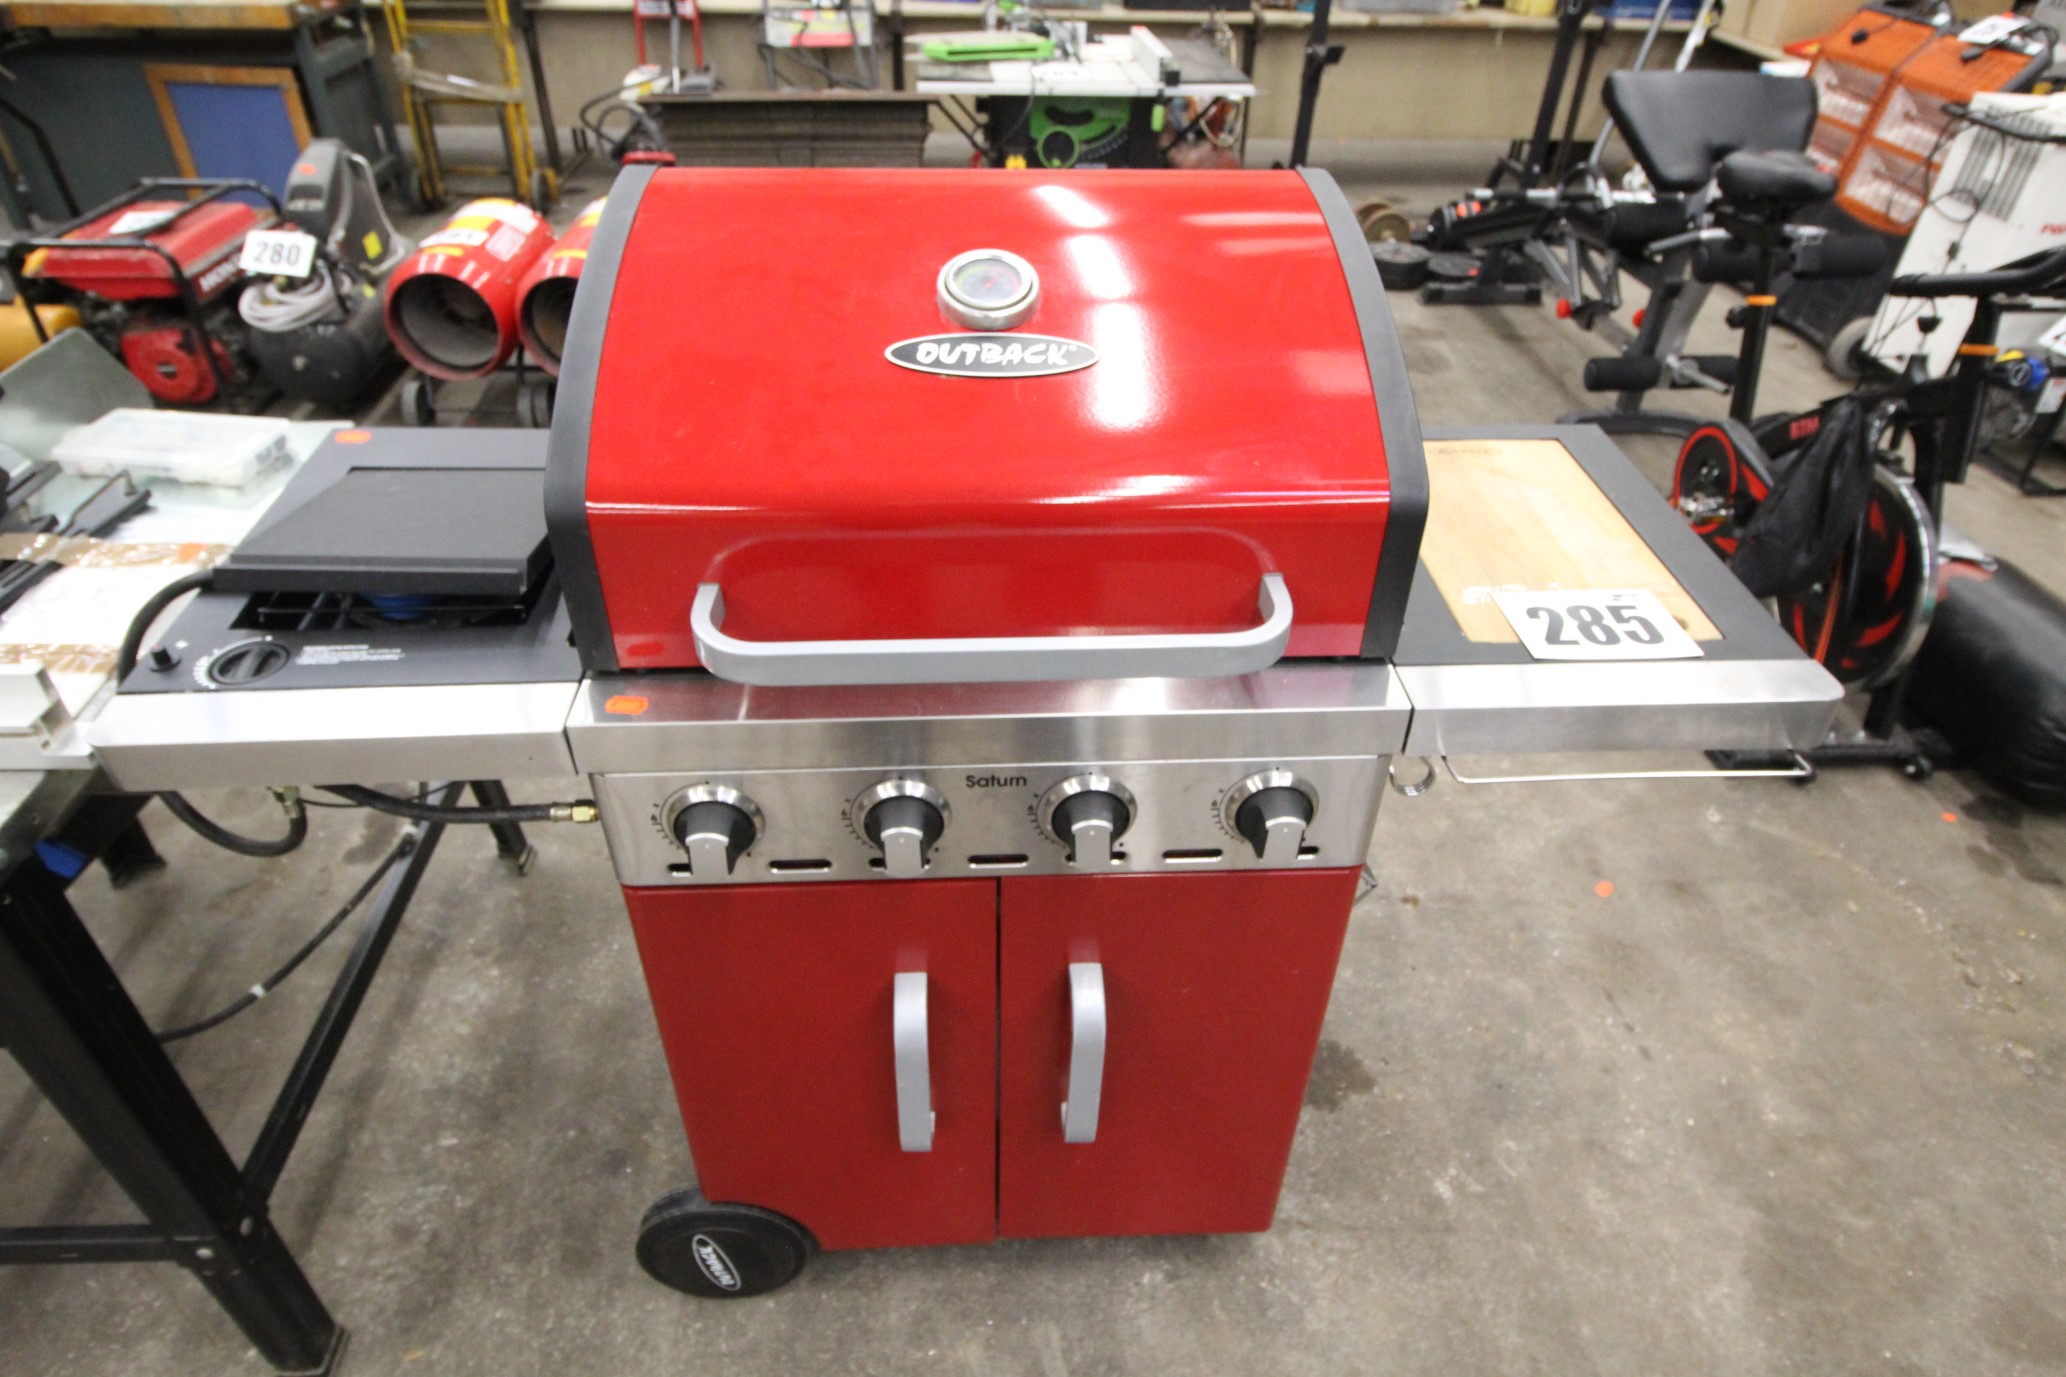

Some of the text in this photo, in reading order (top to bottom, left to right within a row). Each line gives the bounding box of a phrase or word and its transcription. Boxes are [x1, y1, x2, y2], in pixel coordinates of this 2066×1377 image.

[253, 241, 302, 267] 280
[915, 342, 1070, 366] OUTBACK
[1525, 605, 1665, 646] 285
[965, 774, 1027, 788] Saturn
